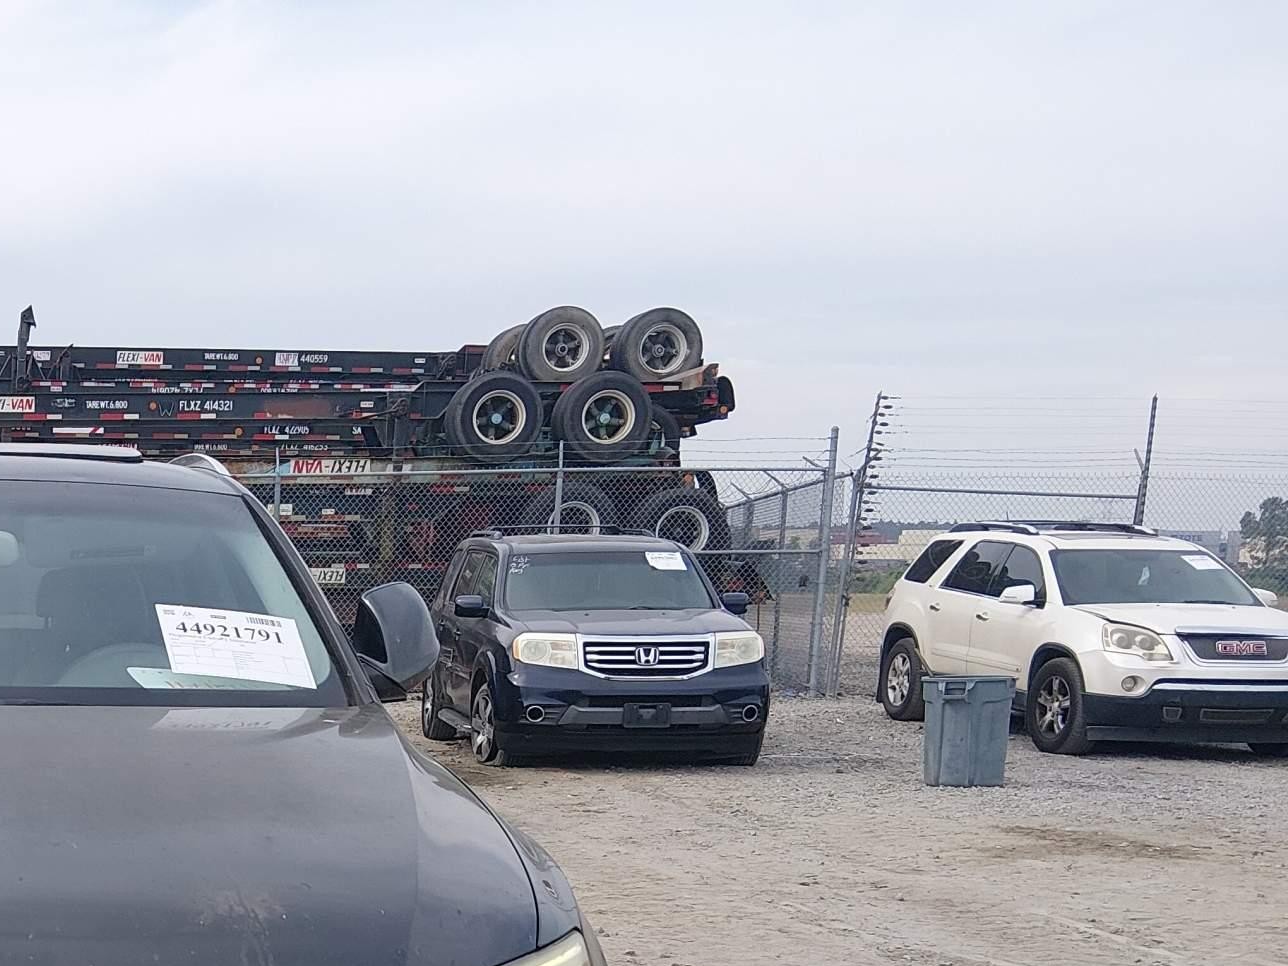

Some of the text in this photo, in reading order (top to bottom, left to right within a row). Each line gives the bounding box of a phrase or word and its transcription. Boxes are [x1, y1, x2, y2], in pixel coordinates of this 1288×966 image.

[117, 353, 162, 363] FLEXI-VAN
[300, 354, 328, 363] 440559
[179, 400, 233, 411] FLXZ 414321
[292, 459, 368, 474] FLEXI-VAN
[175, 621, 285, 645] 44921791
[1215, 640, 1268, 656] GMC
